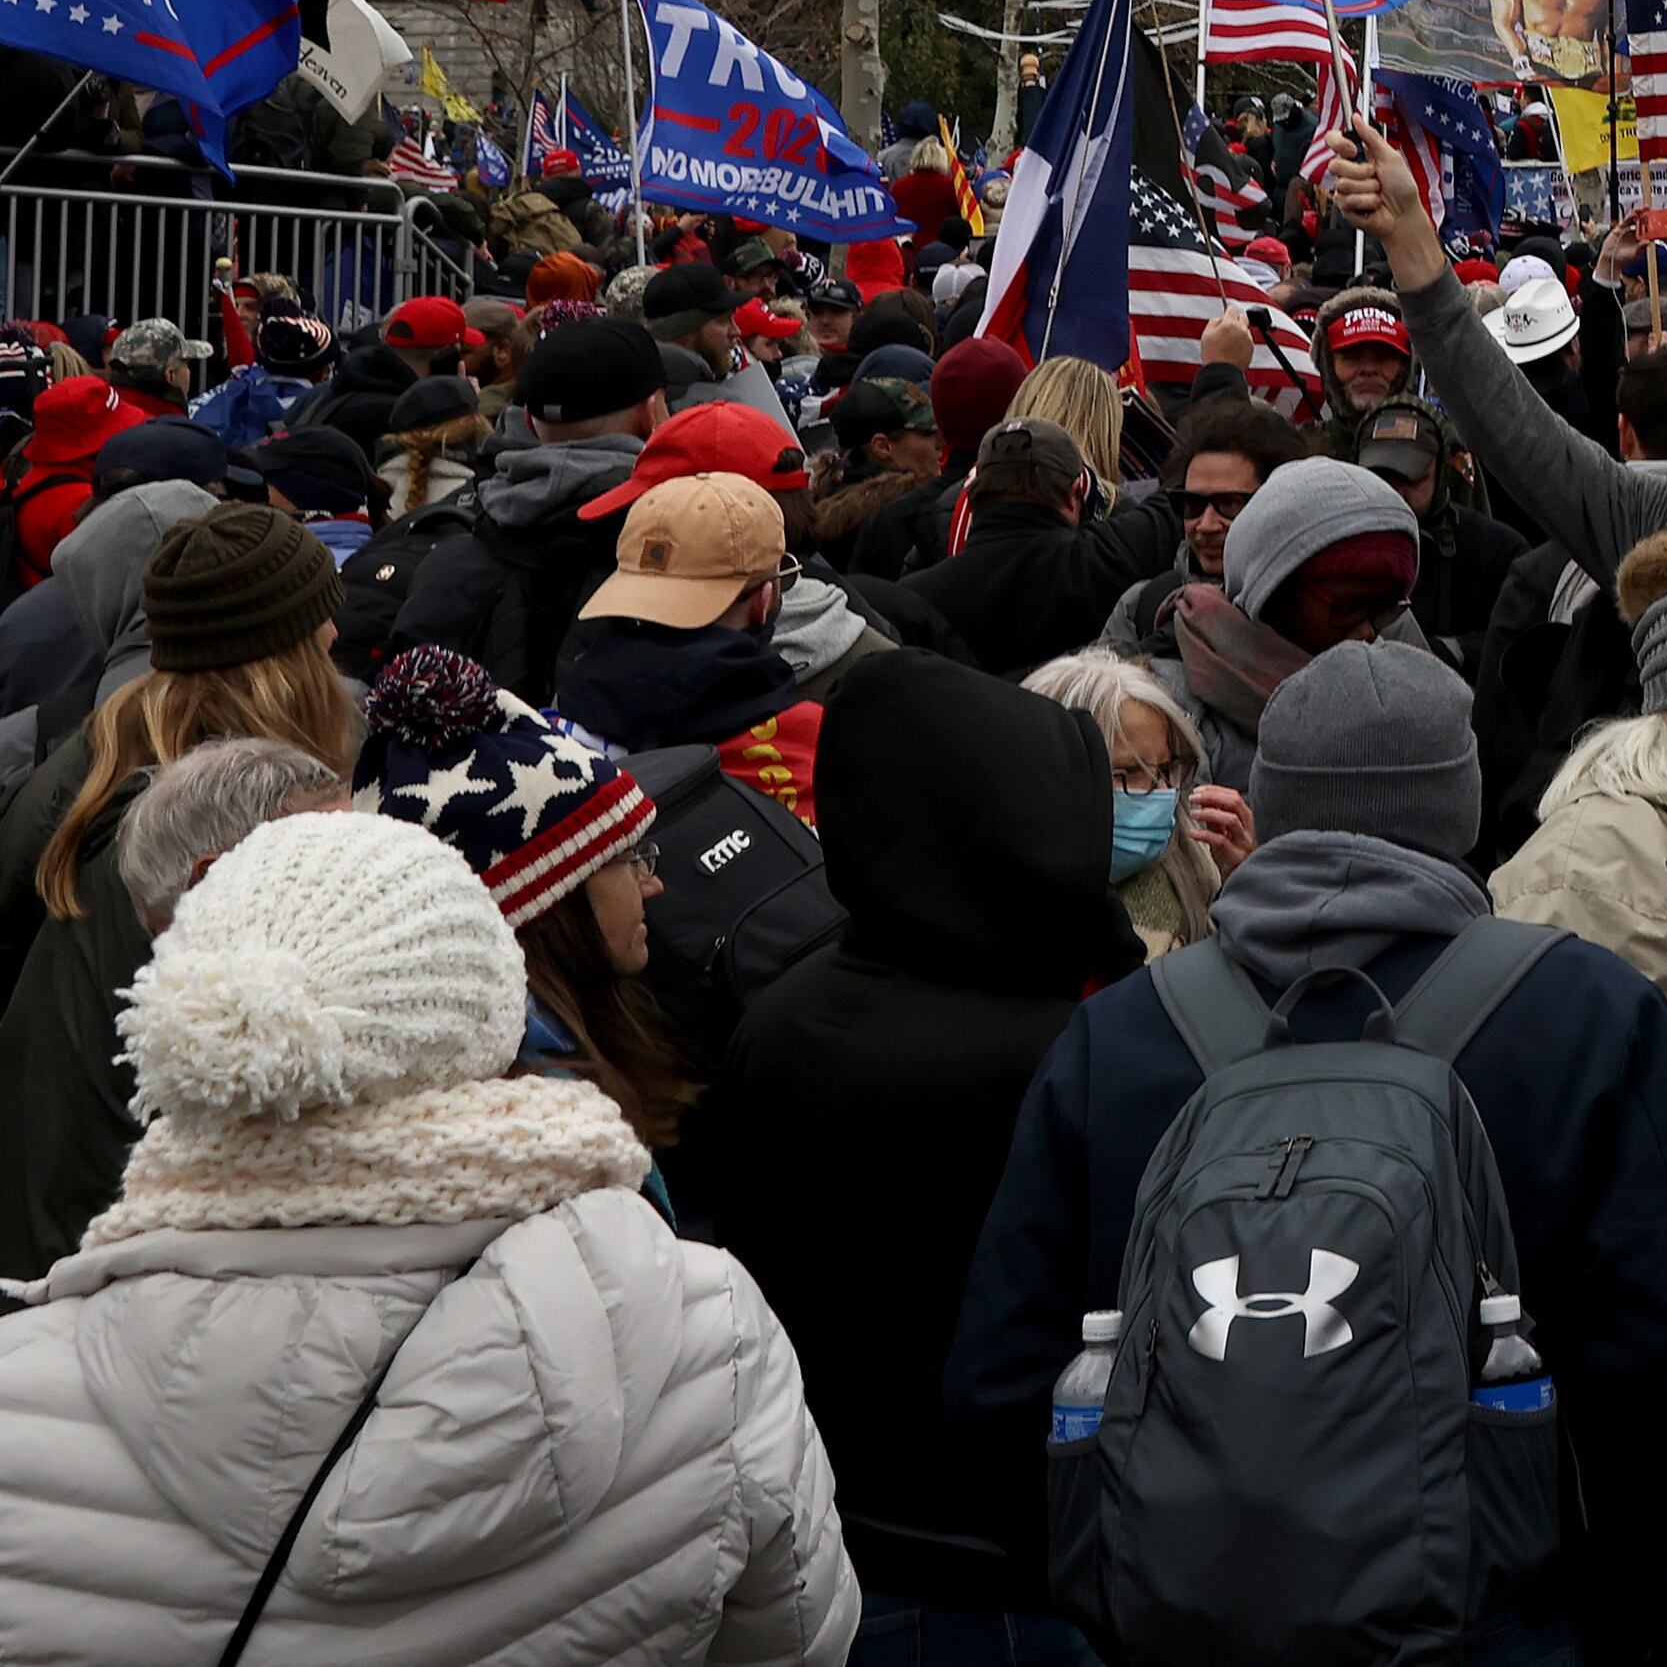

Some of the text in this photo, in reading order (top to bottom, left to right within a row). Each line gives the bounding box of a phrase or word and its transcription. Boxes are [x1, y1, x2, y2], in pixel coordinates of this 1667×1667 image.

[655, 2, 809, 101] TRU
[1424, 72, 1478, 105] ERICA
[722, 101, 830, 175] 202
[651, 146, 688, 182] NO
[755, 166, 889, 222] BULLHIT
[1344, 307, 1397, 327] TRUMP
[701, 829, 751, 873] RTIC
